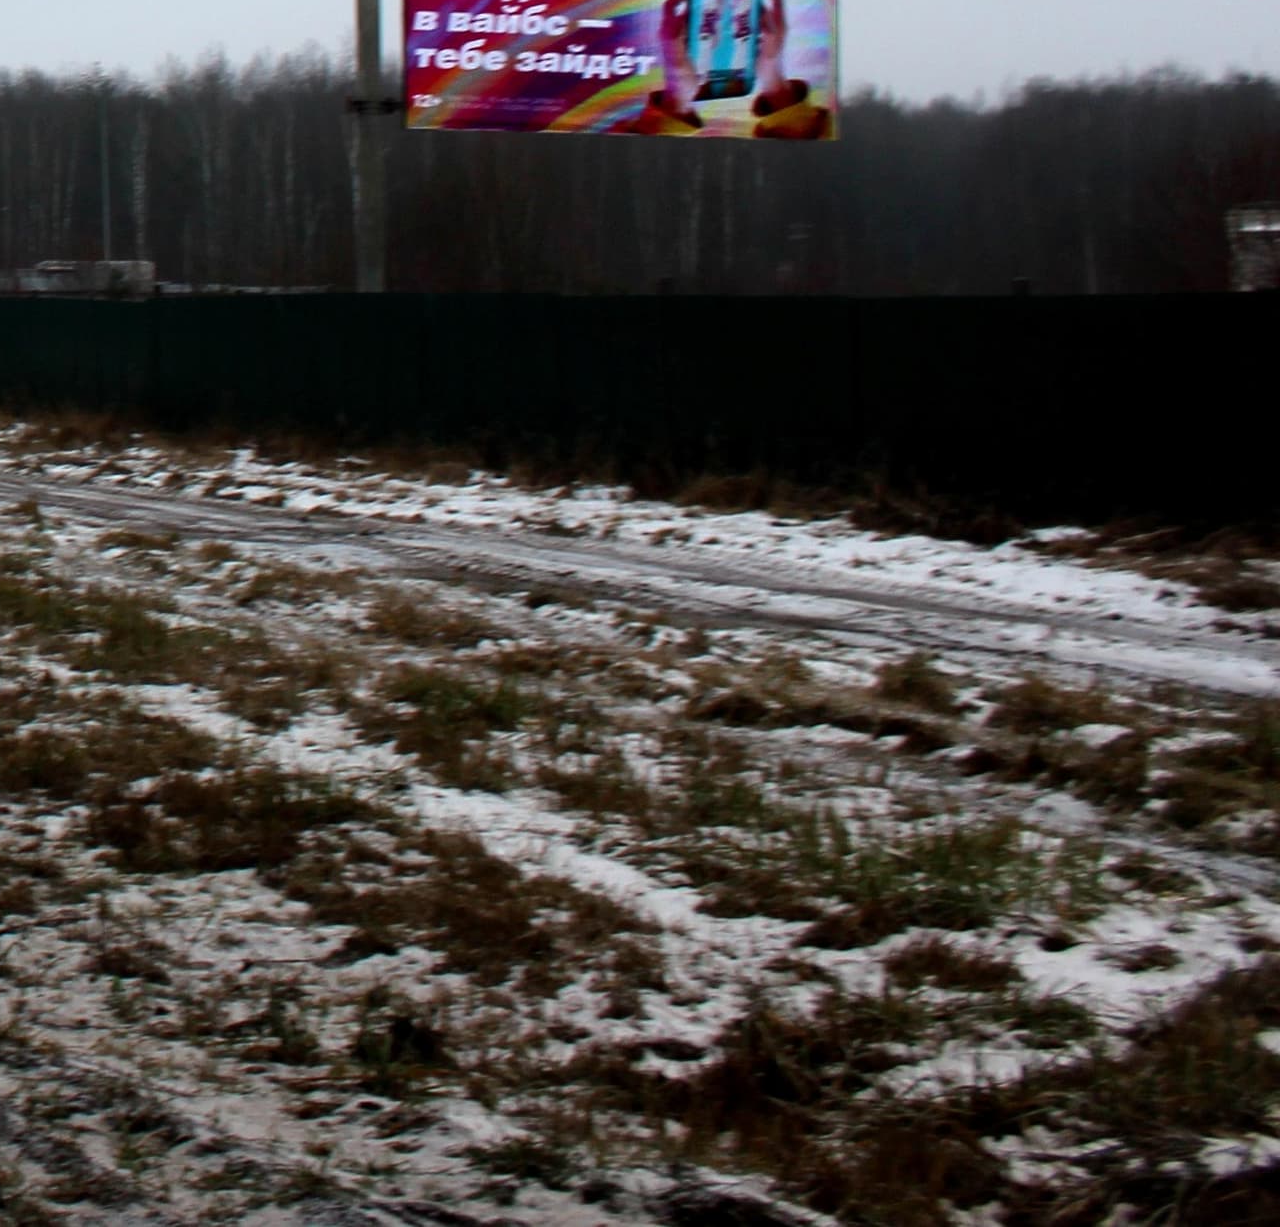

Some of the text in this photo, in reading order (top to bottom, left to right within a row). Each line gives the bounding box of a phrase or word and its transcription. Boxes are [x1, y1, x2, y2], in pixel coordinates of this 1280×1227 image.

[412, 10, 440, 31] в
[446, 4, 570, 36] вайбс
[414, 39, 657, 80] тебе зайдёт
